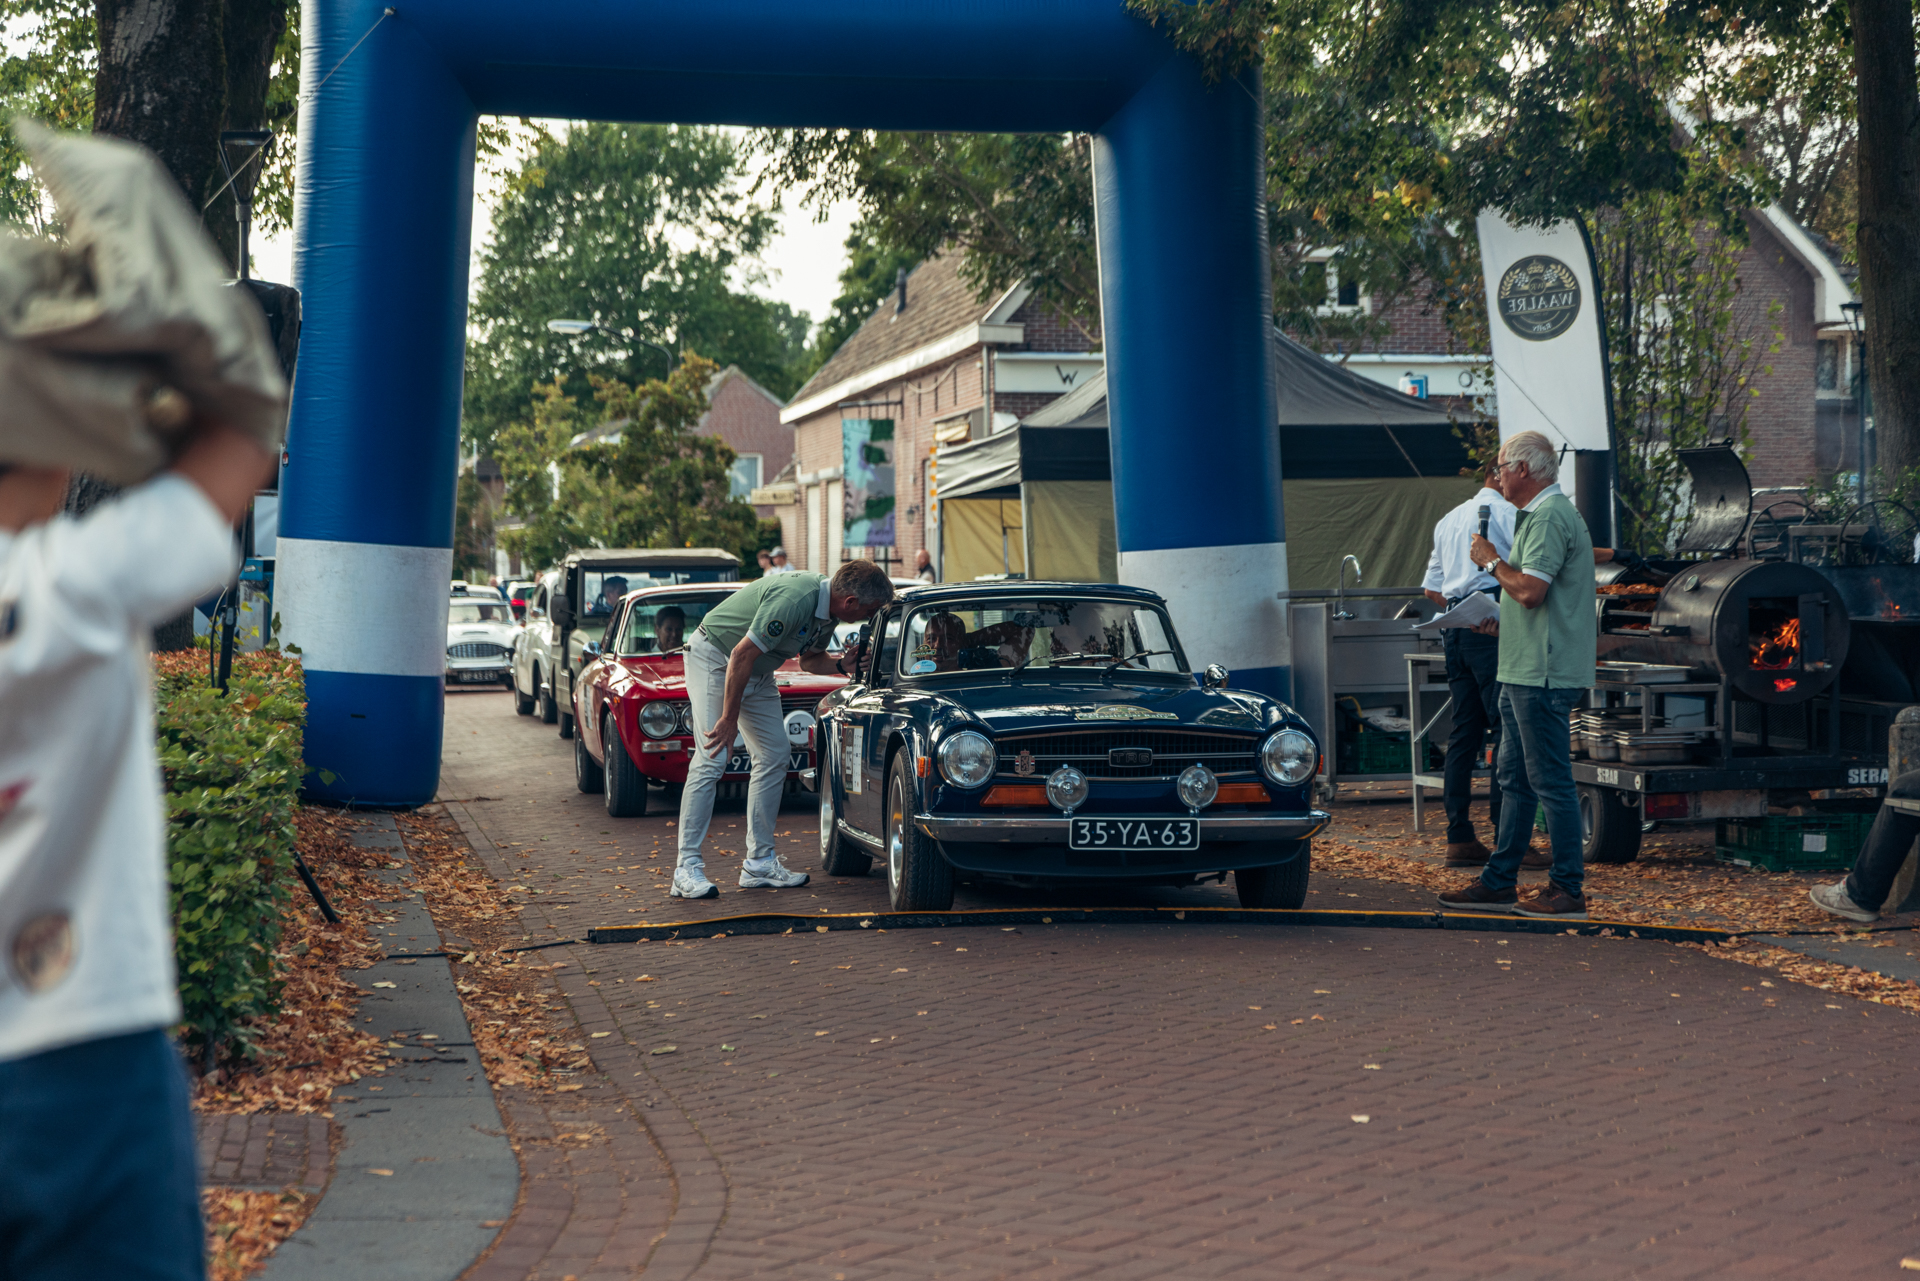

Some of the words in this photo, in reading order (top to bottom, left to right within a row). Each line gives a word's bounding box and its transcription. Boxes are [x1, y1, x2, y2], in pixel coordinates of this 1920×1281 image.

[1112, 752, 1150, 763] TR6
[1848, 768, 1889, 784] SEBA
[1077, 822, 1191, 845] 35-YA-63
